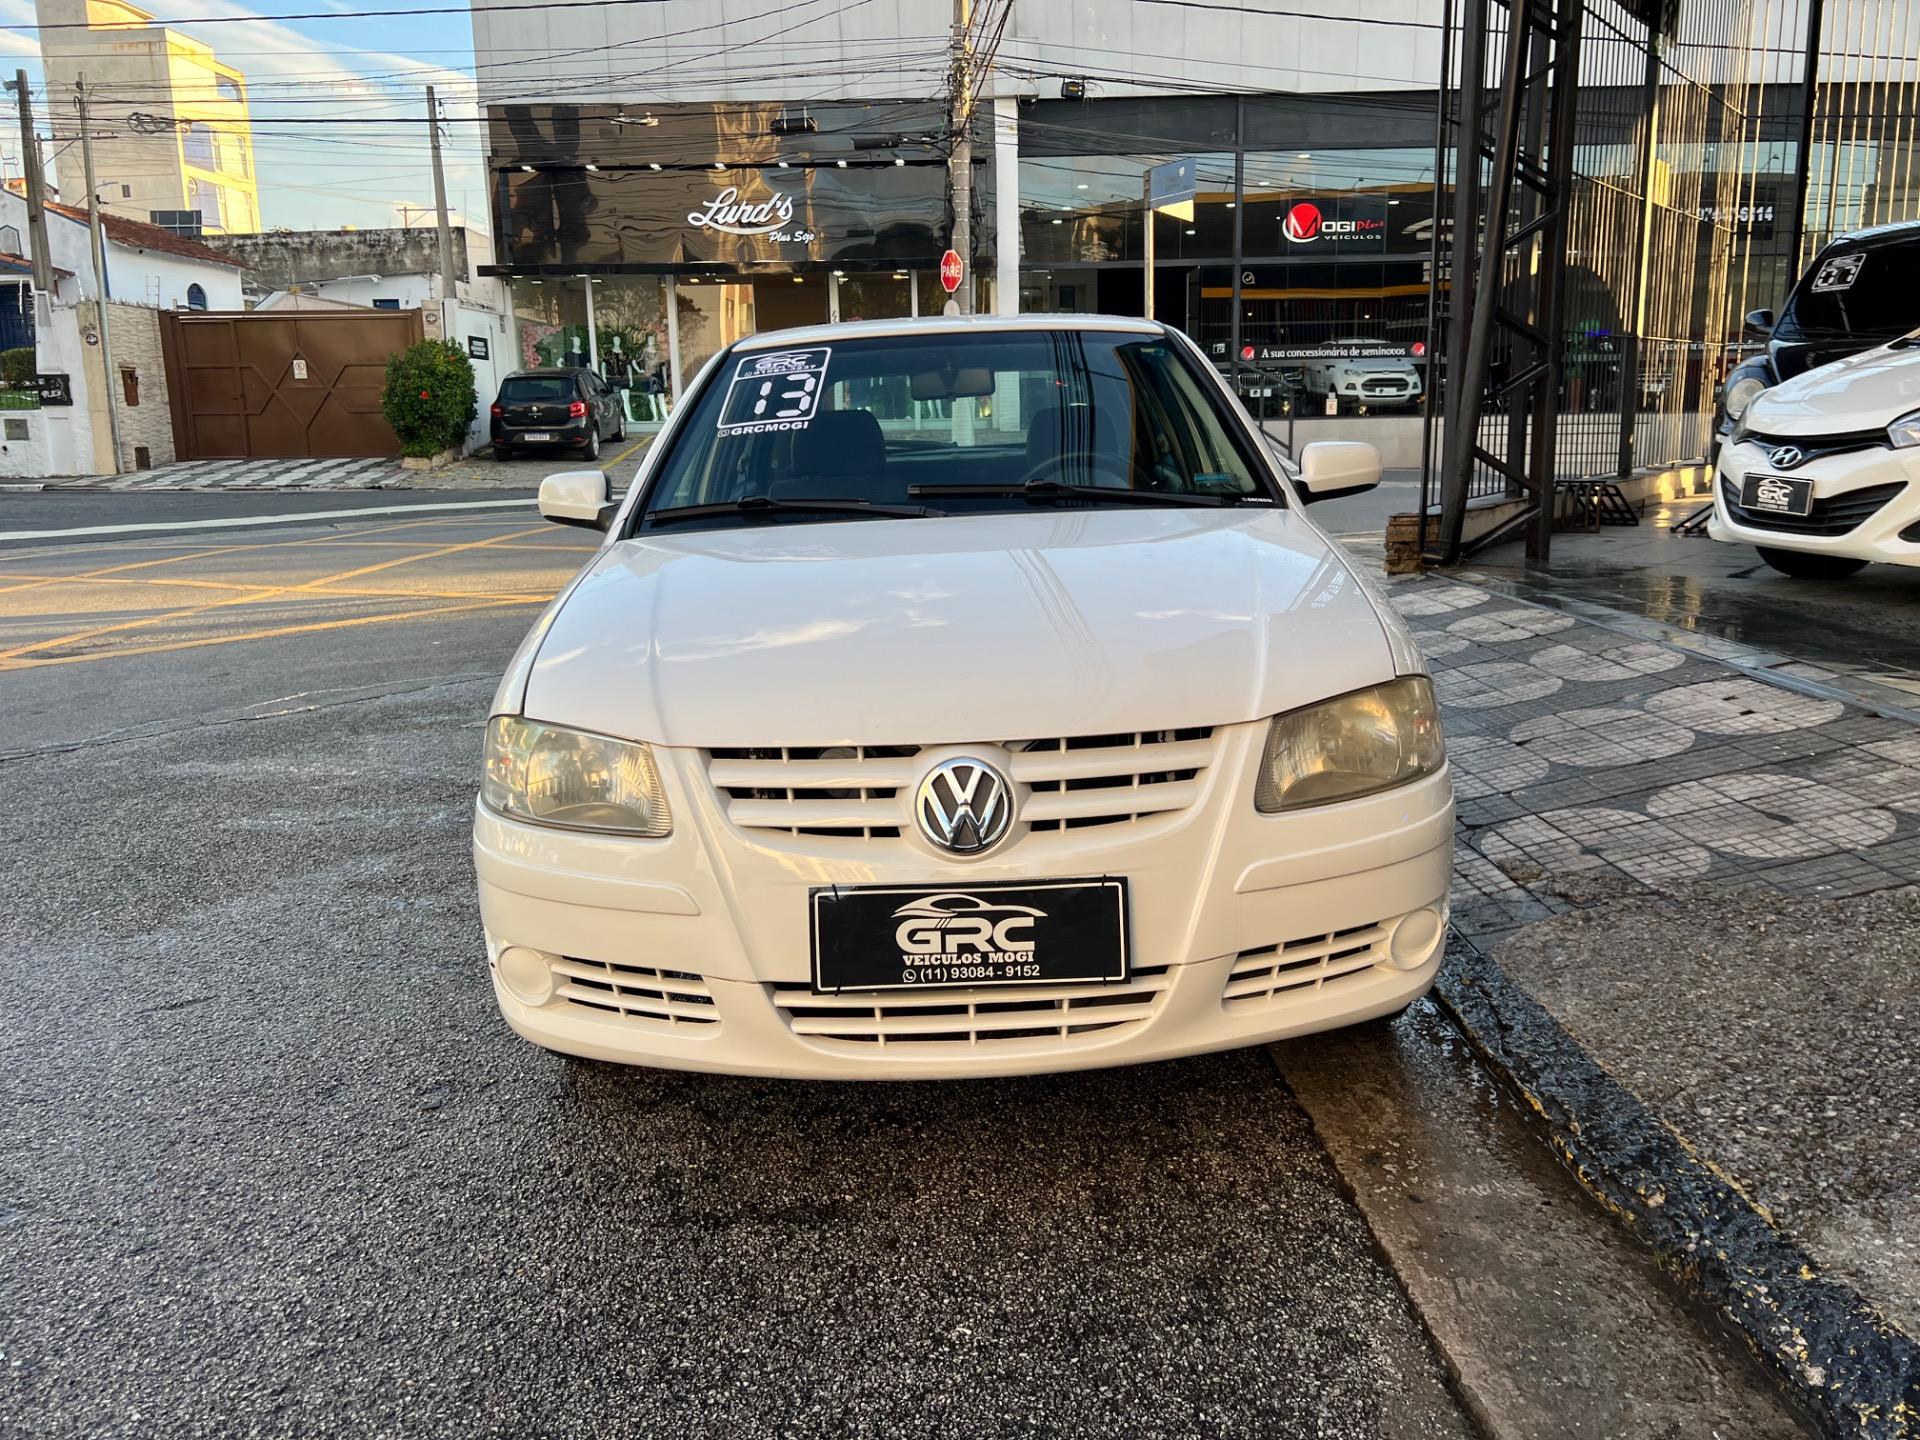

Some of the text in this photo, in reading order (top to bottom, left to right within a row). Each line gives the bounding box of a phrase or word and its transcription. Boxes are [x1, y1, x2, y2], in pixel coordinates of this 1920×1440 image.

[768, 231, 815, 244] Plus Size
[942, 265, 961, 277] PARE
[1261, 346, 1406, 358] A sua concessionária de seminovos
[755, 356, 807, 370] GRC
[754, 372, 816, 418] 13
[731, 421, 809, 436] GRCMOGI
[1758, 486, 1789, 502] GRC
[895, 916, 1035, 954] GRC
[902, 951, 1034, 966] VEICULOS MOGI
[920, 967, 947, 982] (11)
[951, 966, 994, 979] 93084
[1005, 965, 1040, 977] 9152
